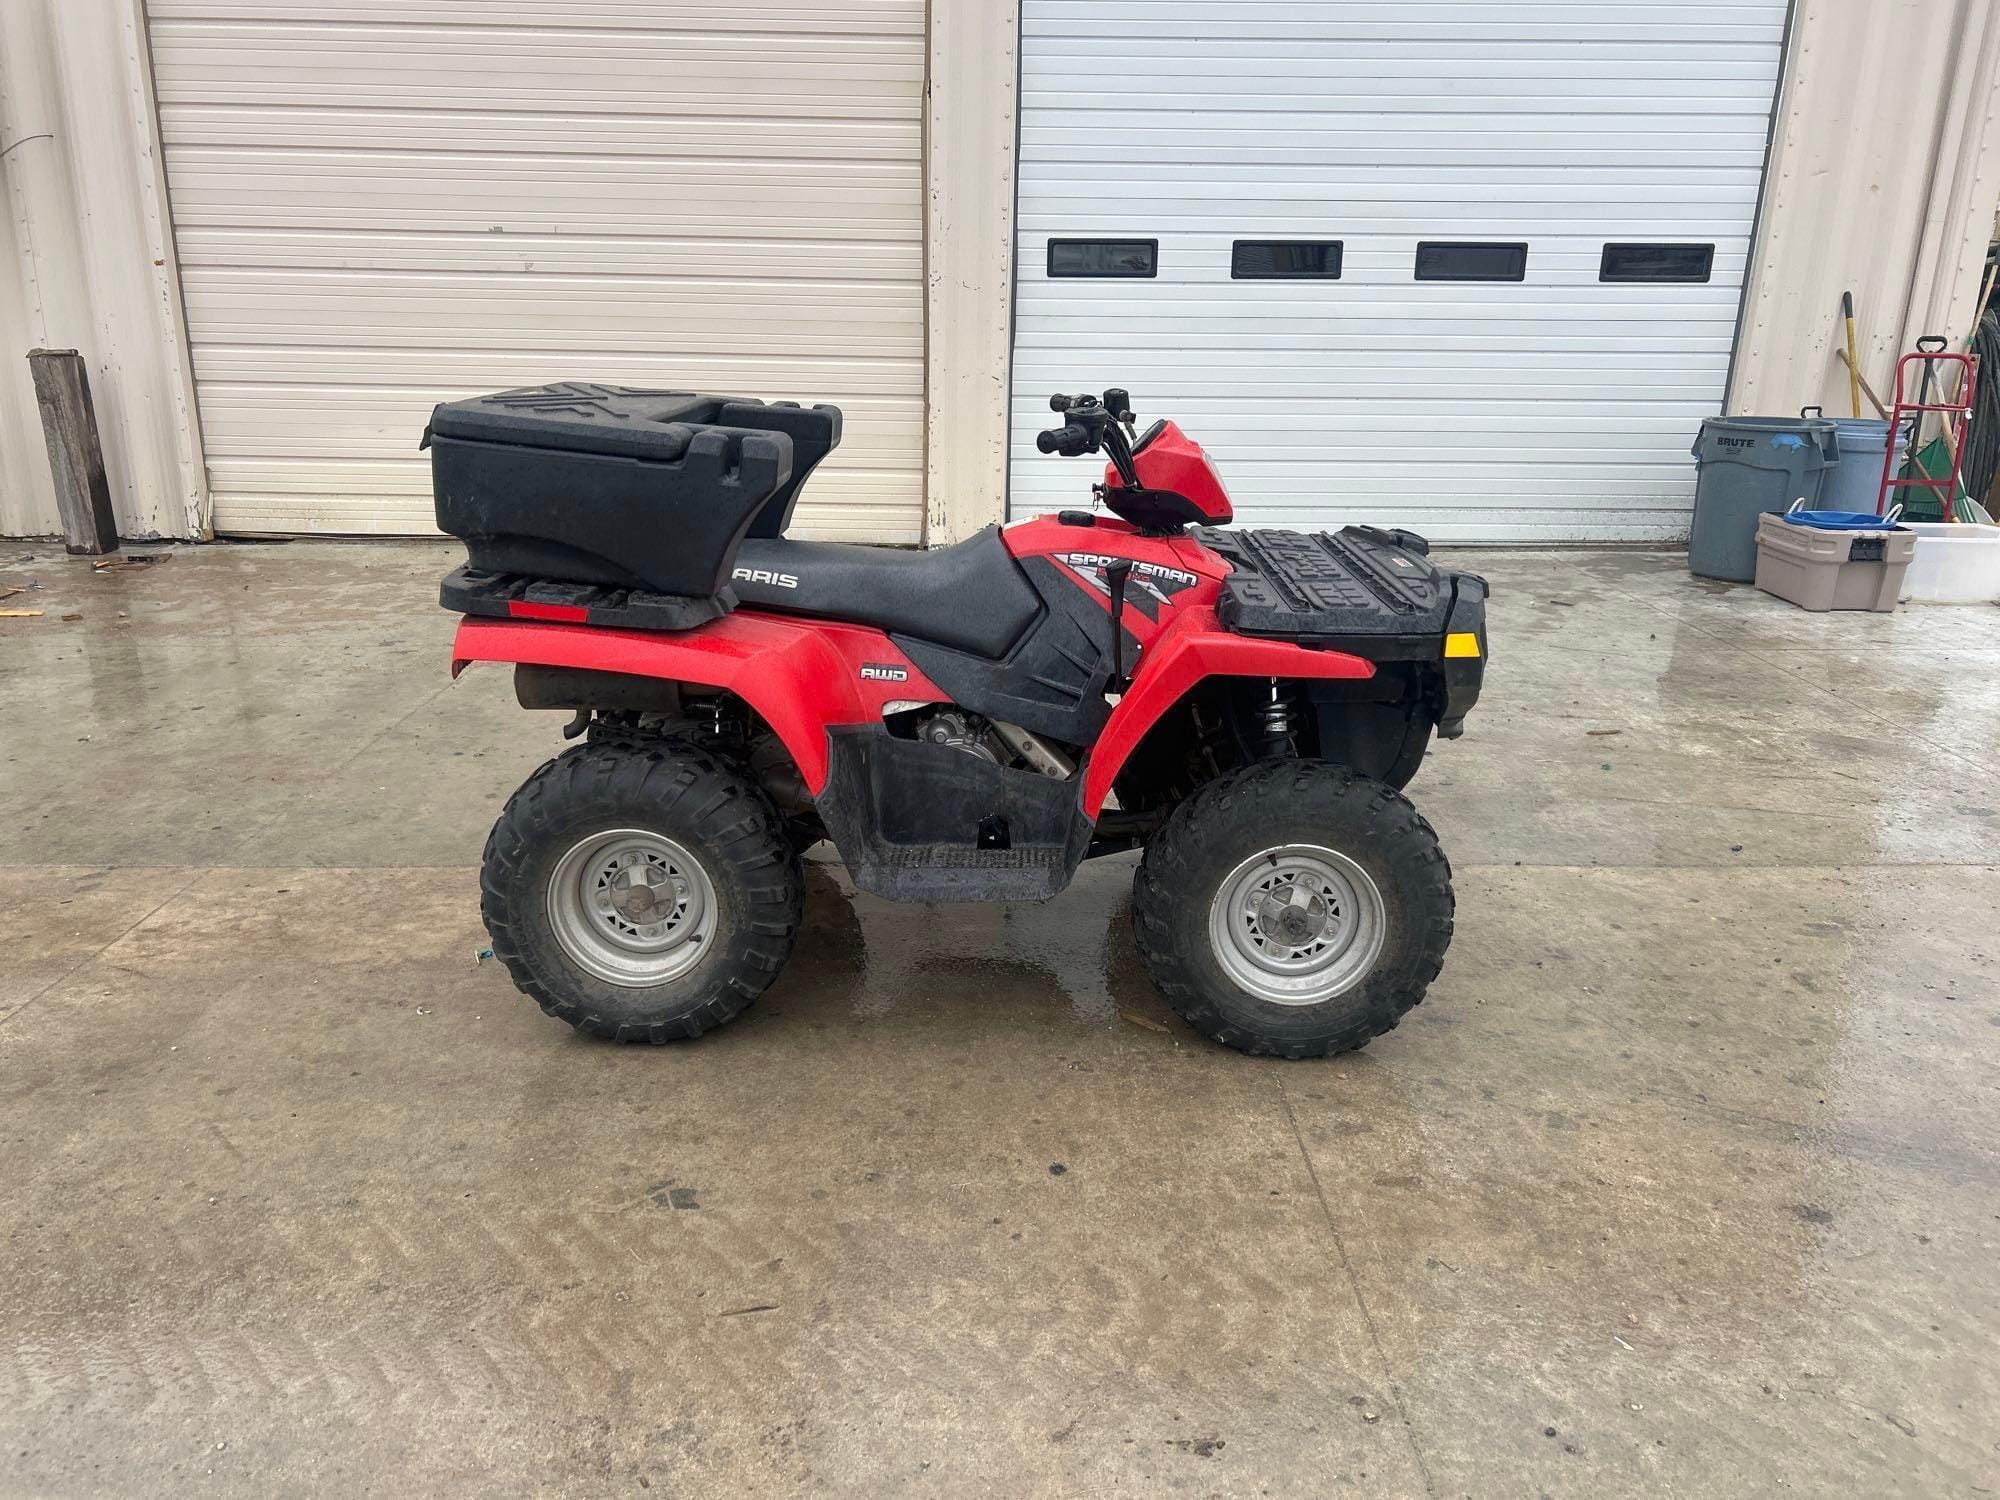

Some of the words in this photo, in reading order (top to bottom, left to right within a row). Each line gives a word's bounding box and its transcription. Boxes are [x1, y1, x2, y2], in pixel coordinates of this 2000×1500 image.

[1717, 436, 1755, 448] BRUTE
[731, 567, 799, 589] ARIS
[1068, 552, 1198, 587] SPOTSMAN
[860, 668, 908, 682] AWD
